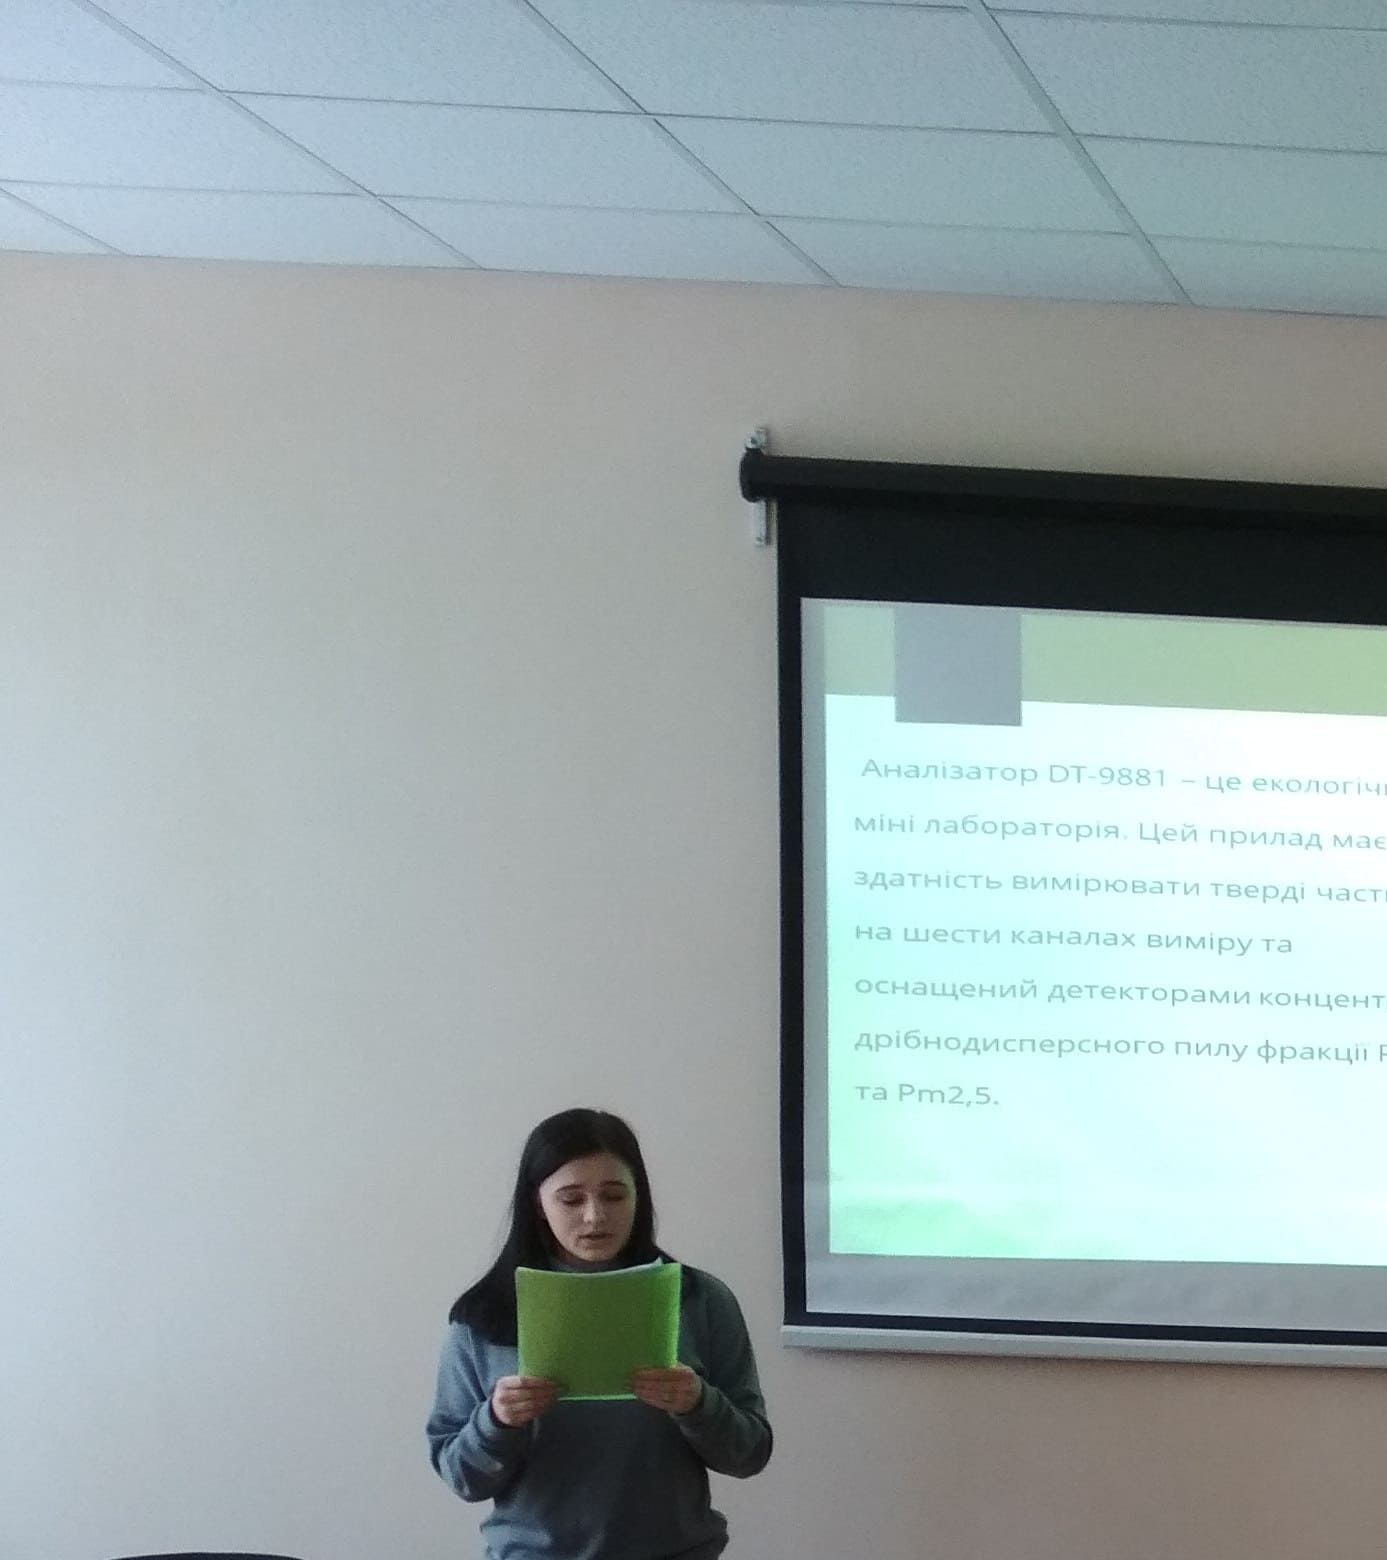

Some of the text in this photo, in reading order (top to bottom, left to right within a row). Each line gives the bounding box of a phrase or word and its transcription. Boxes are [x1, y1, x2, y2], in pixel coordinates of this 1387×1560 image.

[860, 758, 1039, 787] Аналізатор
[1048, 764, 1165, 788] DT-9881
[1205, 775, 1243, 795] це
[854, 813, 1387, 853] міні лабораторія. Цей прилад має
[853, 869, 1003, 892] здатність
[1012, 872, 1200, 897] вимірювати
[1209, 881, 1305, 905] тверді
[854, 924, 1293, 957] на шести каналах виміру та
[854, 978, 1038, 1002] оснащений
[1047, 983, 1251, 1008] детекторами
[853, 1028, 1166, 1059] дрібнодисперсного
[1174, 1040, 1249, 1064] пилу
[1256, 1039, 1368, 1066] фракції
[853, 1083, 1000, 1109] та Pm2,5.
